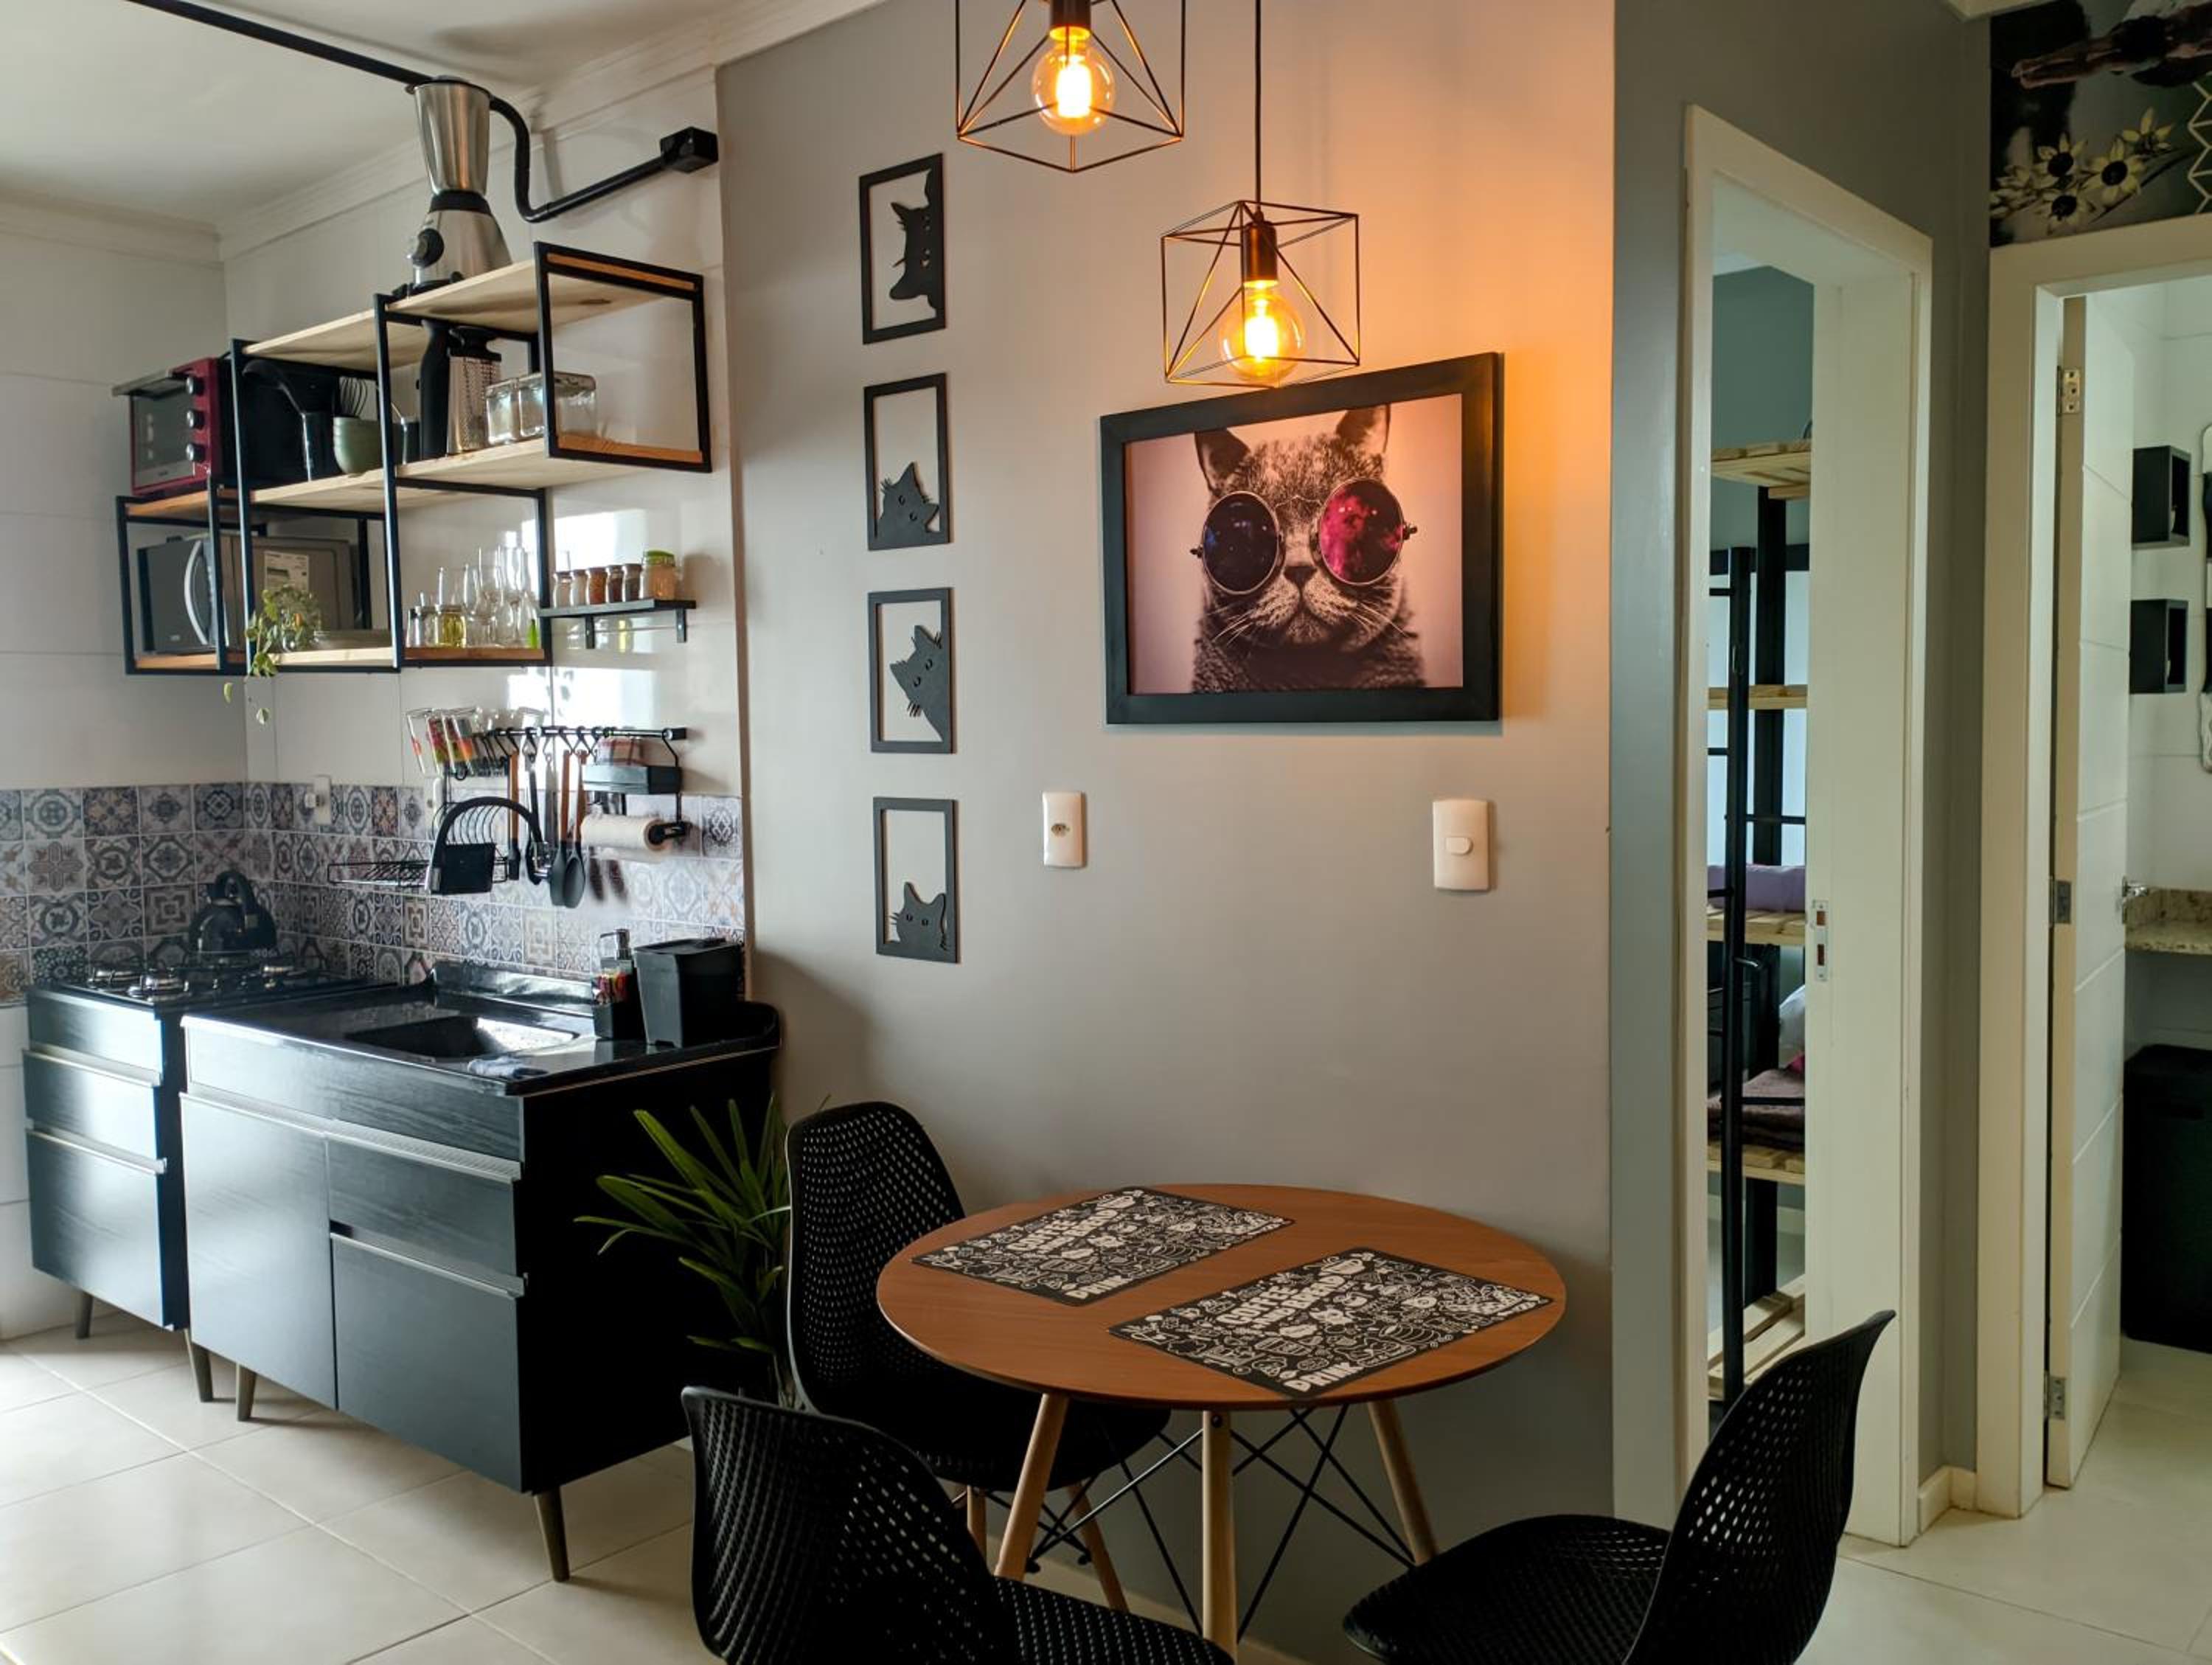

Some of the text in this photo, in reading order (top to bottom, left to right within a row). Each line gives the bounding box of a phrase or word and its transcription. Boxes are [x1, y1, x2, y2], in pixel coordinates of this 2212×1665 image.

[1006, 1220, 1077, 1251] COFFEE
[1065, 1276, 1134, 1299] DRINK
[1281, 1275, 1345, 1309] BREAD
[1216, 1285, 1299, 1324] COFFEE
[1284, 1362, 1363, 1392] DRINK
